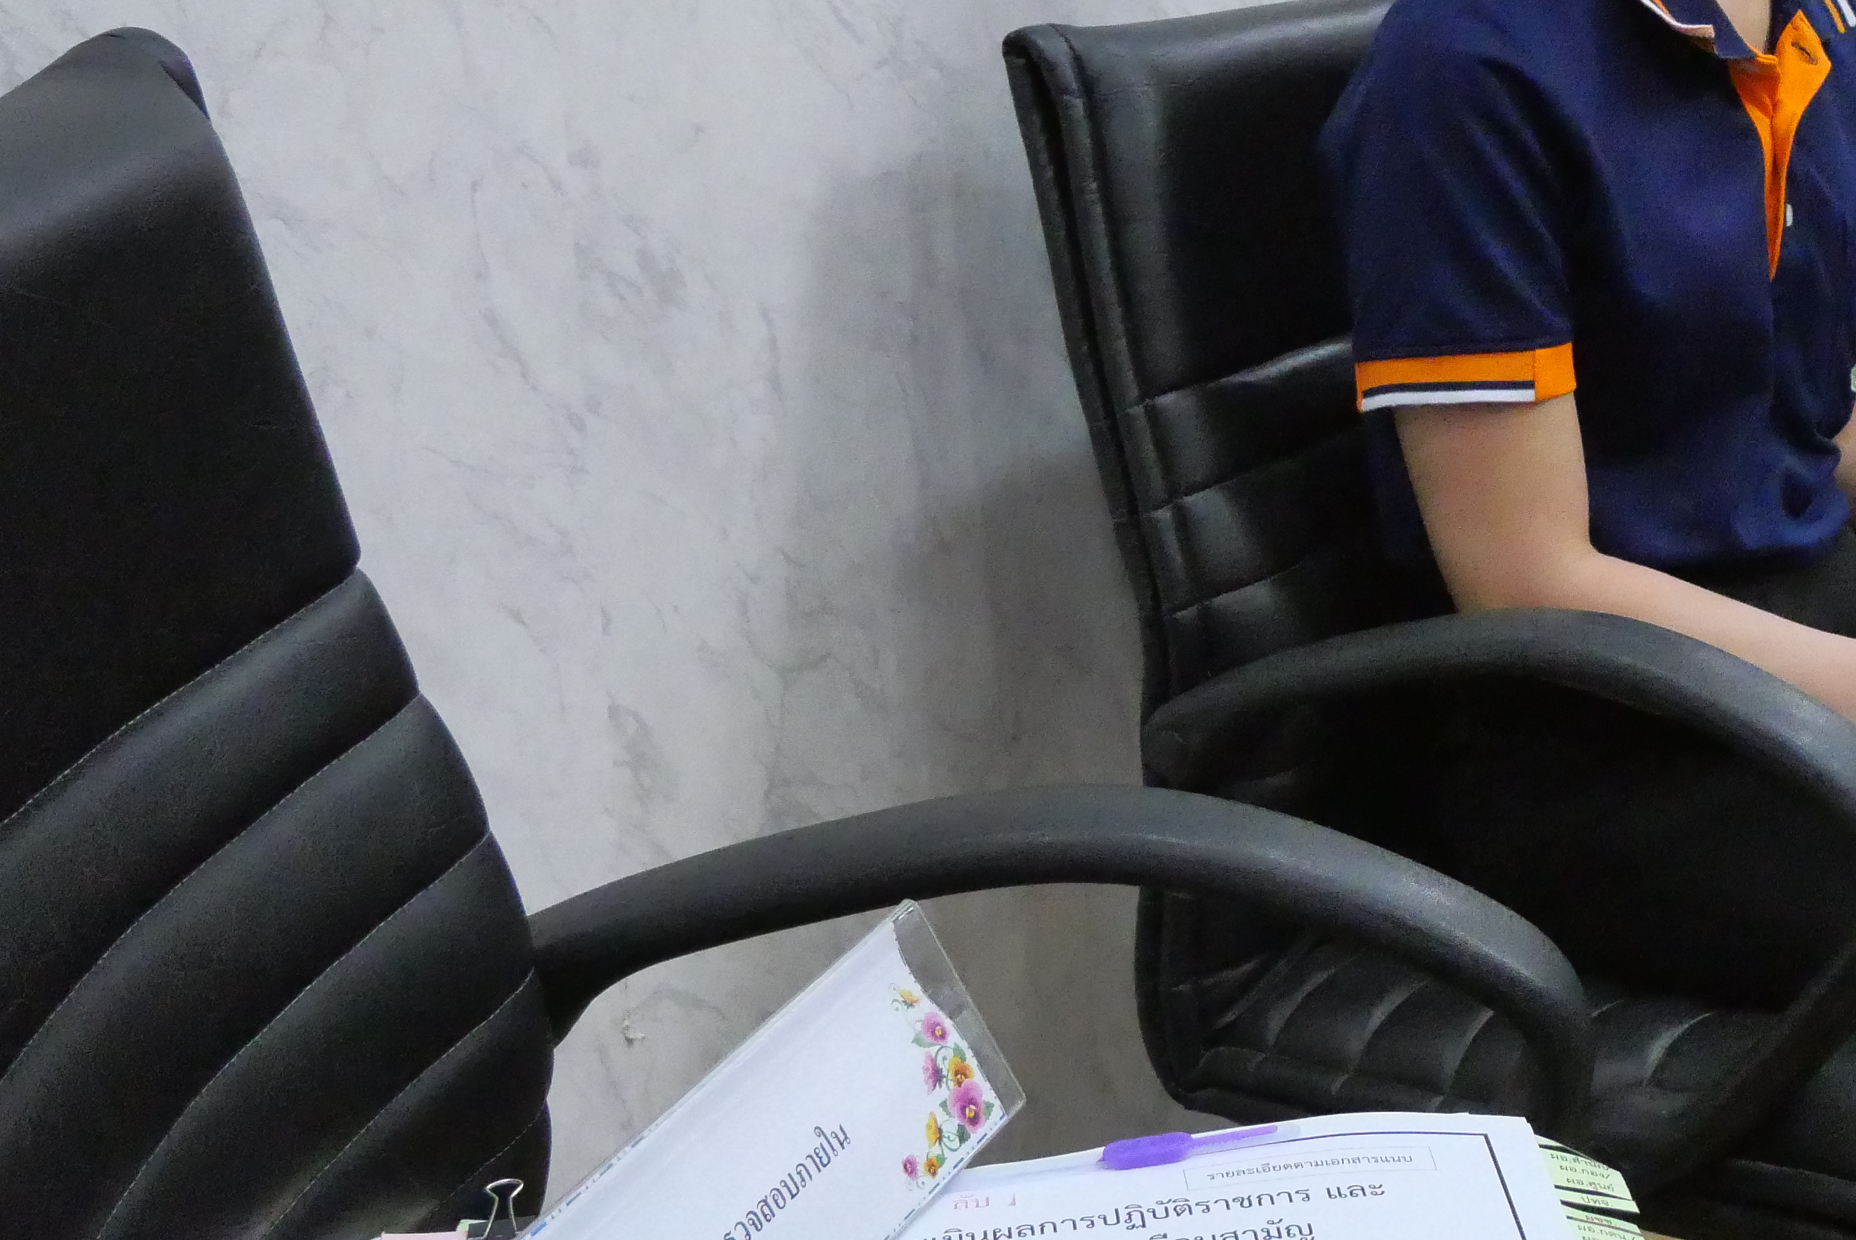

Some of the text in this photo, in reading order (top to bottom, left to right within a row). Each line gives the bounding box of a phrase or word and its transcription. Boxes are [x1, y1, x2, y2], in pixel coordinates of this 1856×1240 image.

[1206, 1155, 1413, 1180] รายละเอียดตามเอกสารแนบ
[1326, 1184, 1385, 1199] และ
